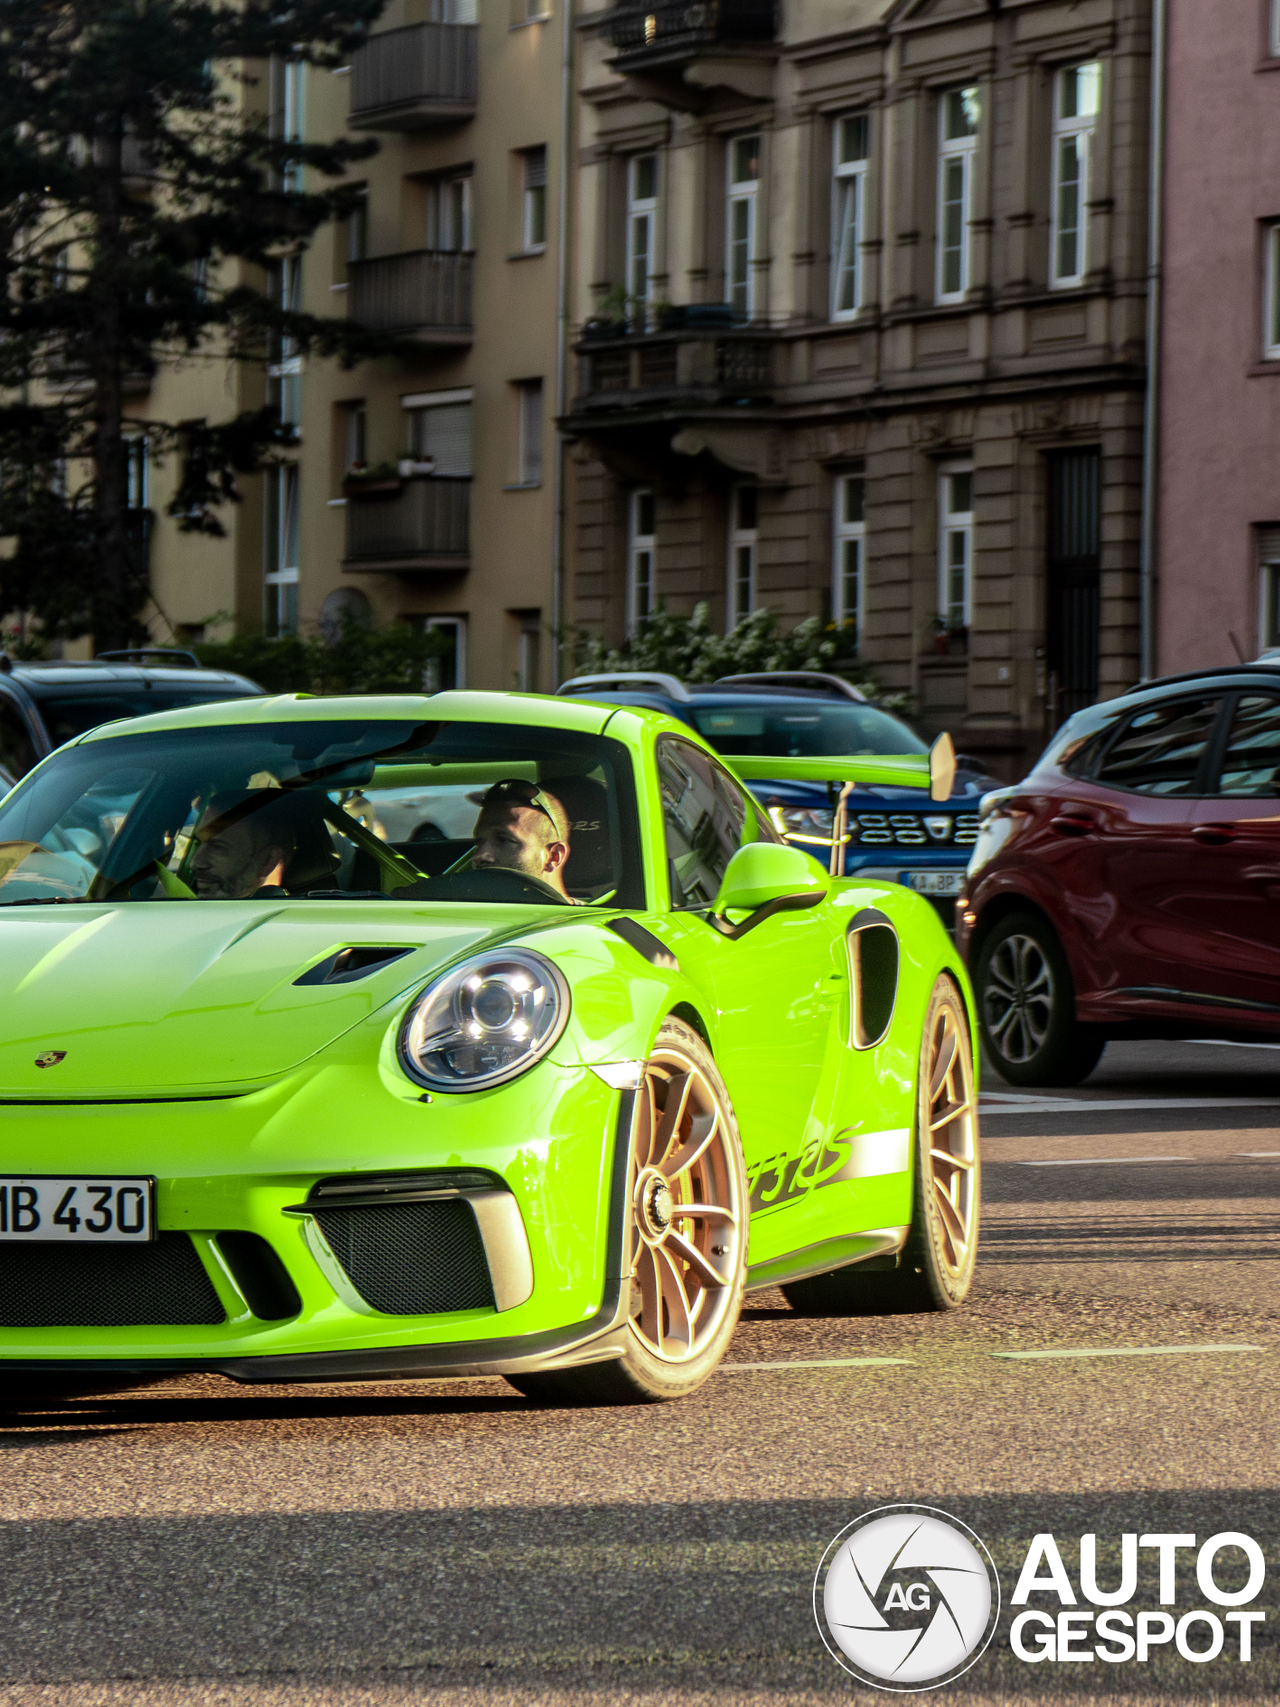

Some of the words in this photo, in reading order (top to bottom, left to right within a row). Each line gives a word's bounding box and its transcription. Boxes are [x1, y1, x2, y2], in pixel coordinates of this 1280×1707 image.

[909, 875, 926, 890] KA
[937, 875, 954, 890] BP
[52, 1186, 145, 1234] 430
